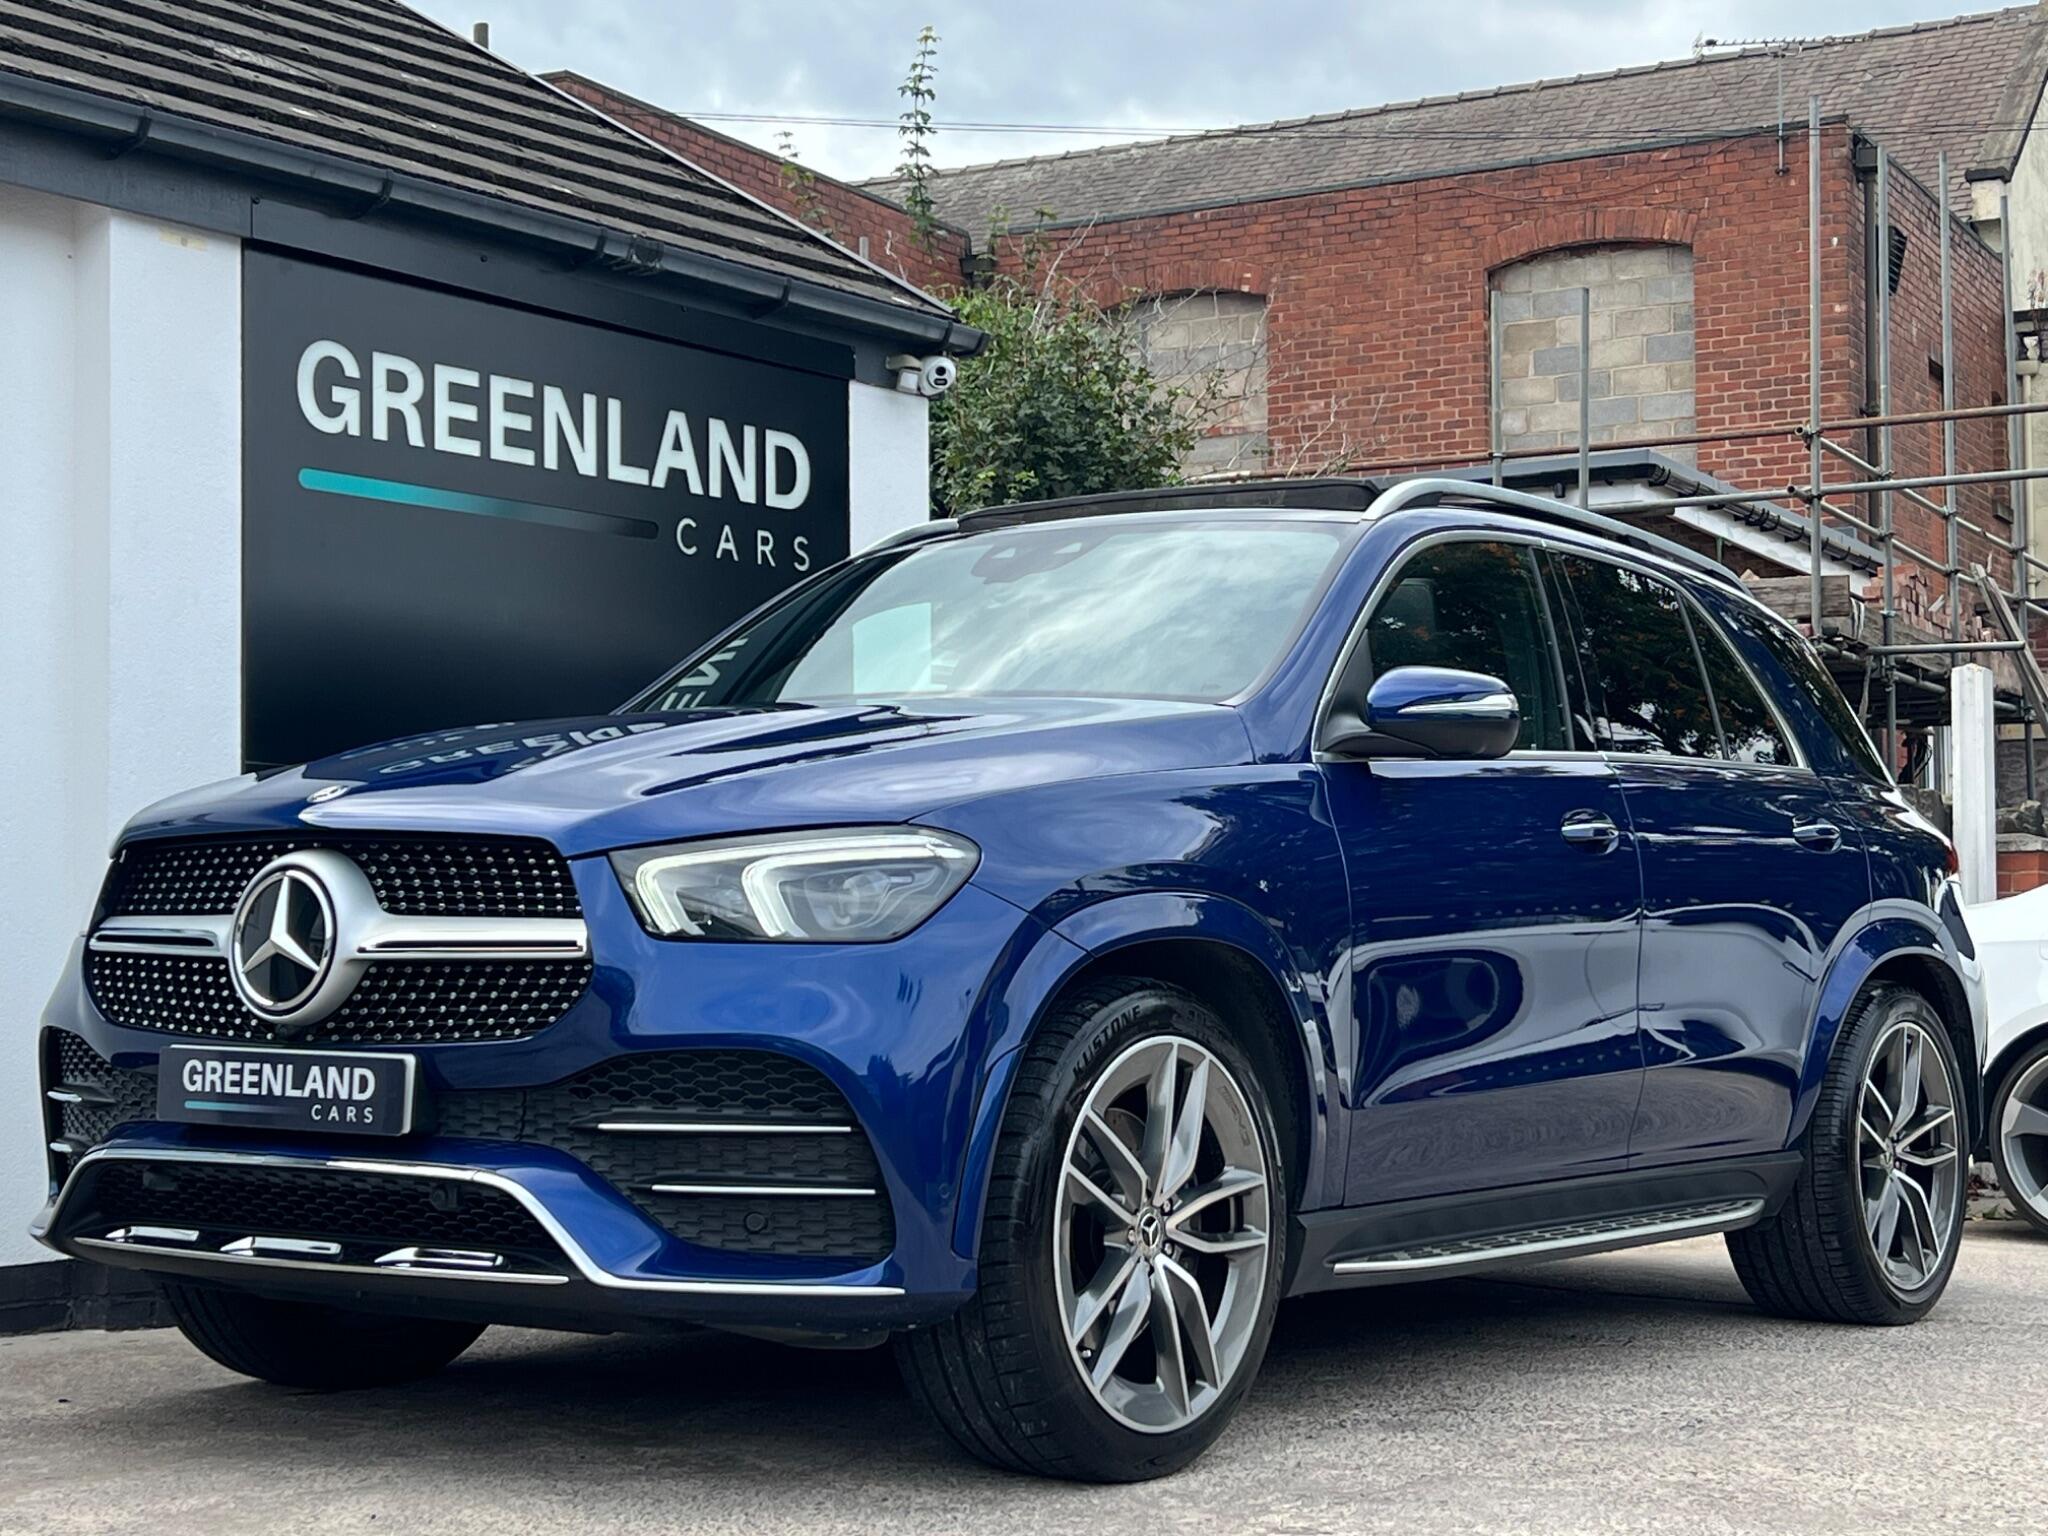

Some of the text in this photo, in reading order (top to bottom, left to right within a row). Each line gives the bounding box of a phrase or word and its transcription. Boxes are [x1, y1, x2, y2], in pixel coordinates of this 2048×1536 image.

[298, 340, 811, 510] GREENLAND
[676, 518, 810, 571] CARS
[183, 1059, 375, 1101] GREENLAND
[311, 1104, 373, 1123] CARS
